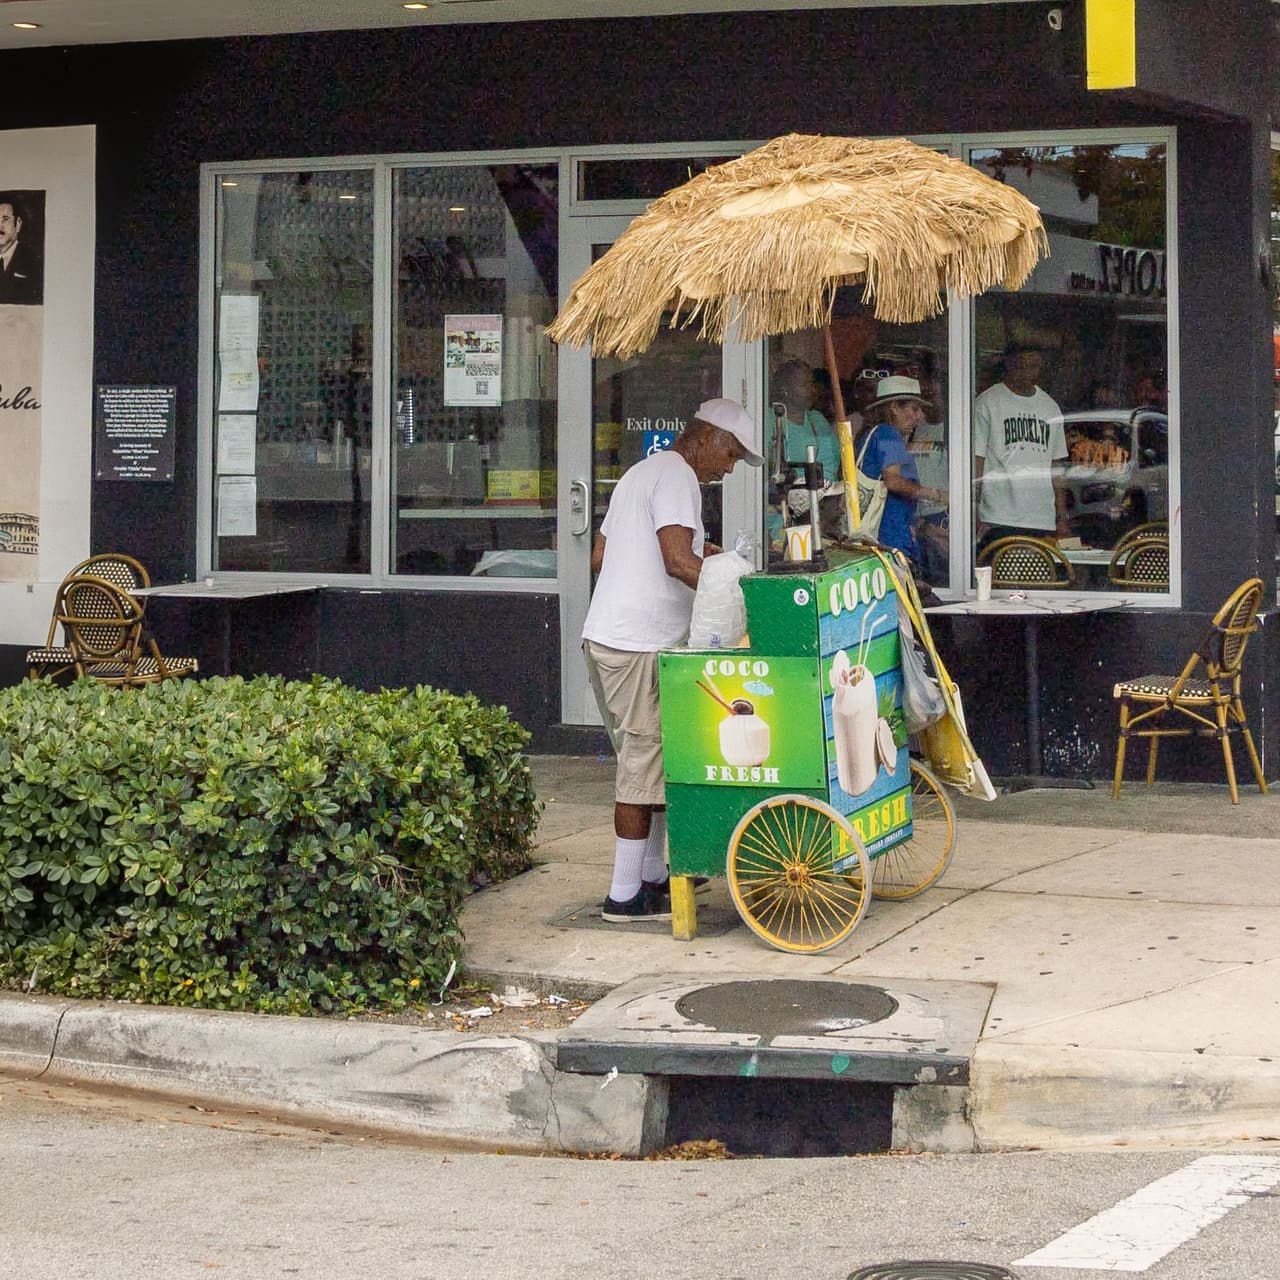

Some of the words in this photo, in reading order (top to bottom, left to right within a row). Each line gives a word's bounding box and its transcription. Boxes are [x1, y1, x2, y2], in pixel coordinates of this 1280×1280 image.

[626, 417, 653, 431] Exit
[655, 417, 687, 434] Only
[1003, 415, 1051, 449] BROOKLYN
[829, 567, 887, 617] COCO
[705, 659, 770, 677] COCO
[704, 764, 780, 784] FRESH
